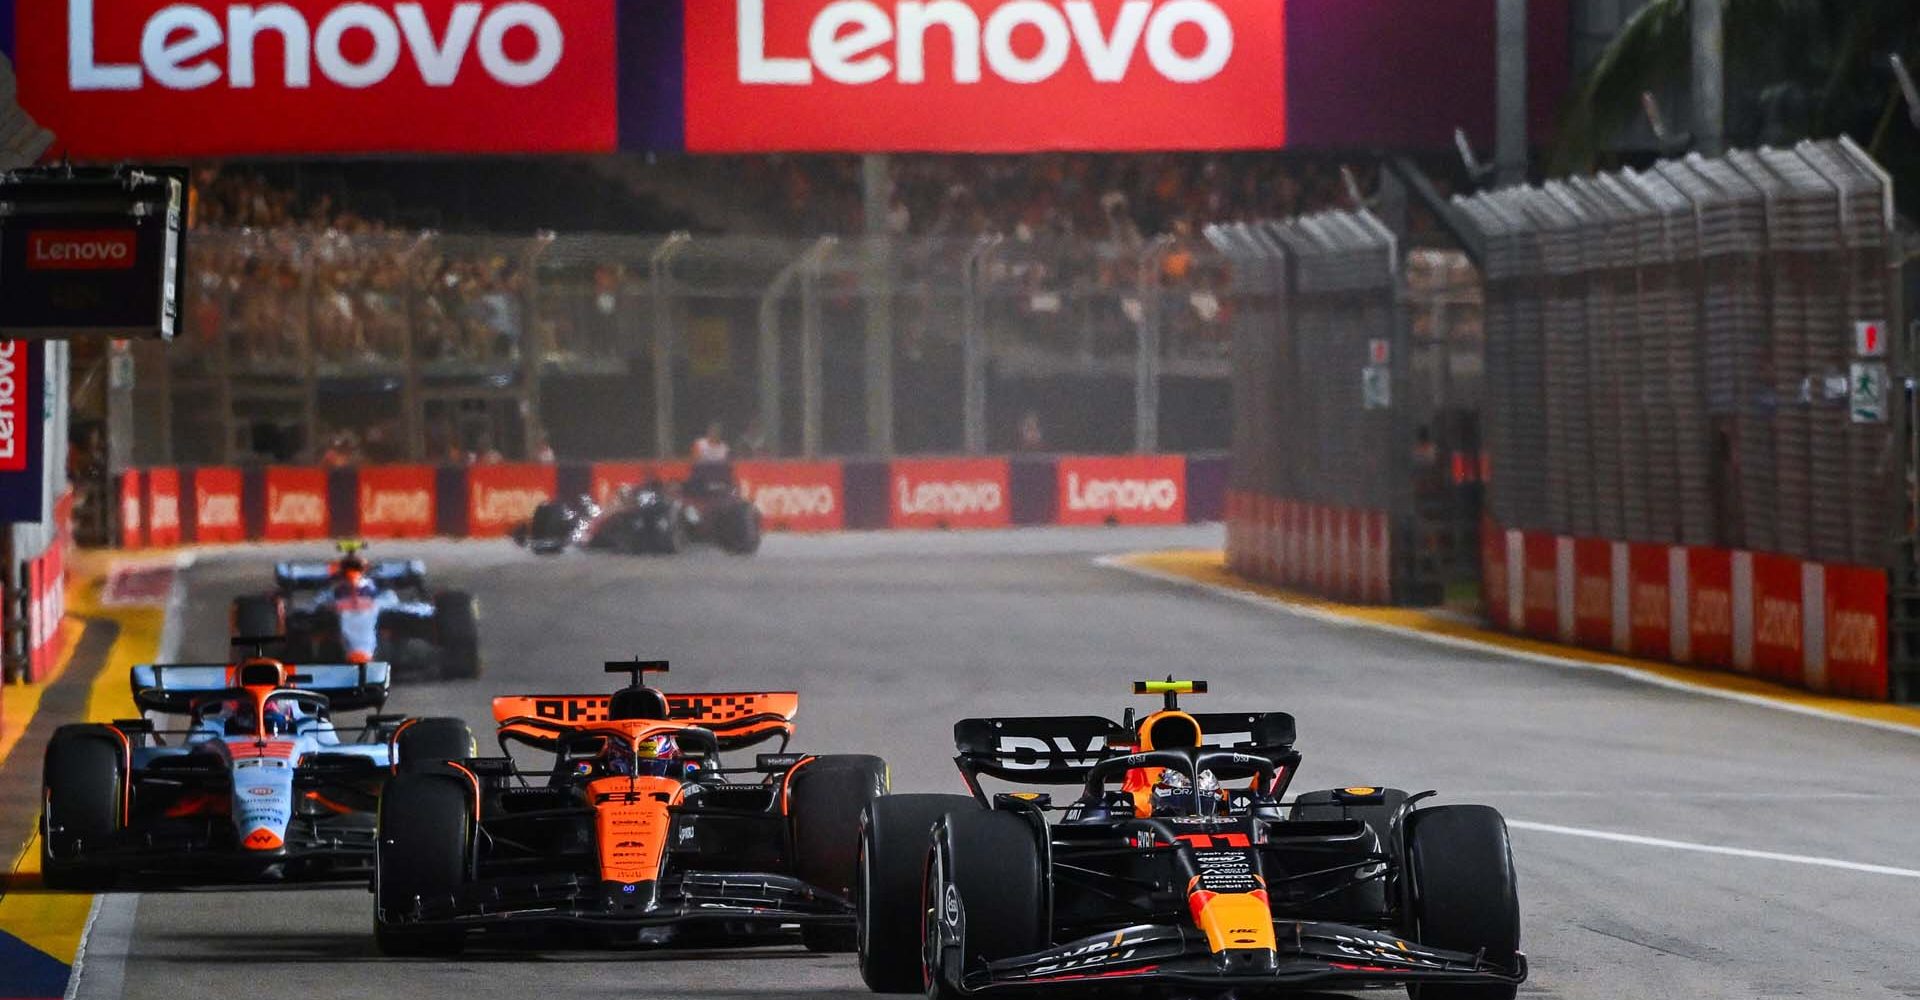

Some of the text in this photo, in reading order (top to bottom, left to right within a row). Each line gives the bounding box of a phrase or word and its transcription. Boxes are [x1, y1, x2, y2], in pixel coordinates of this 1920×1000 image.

[68, 0, 564, 90] Lenovo
[737, 0, 1235, 84] Lenovo
[36, 239, 127, 260] Lenovo
[899, 474, 1002, 514] Lenovo
[1067, 471, 1178, 511] Lenovo
[1172, 833, 1251, 848] 11
[623, 884, 635, 893] 60
